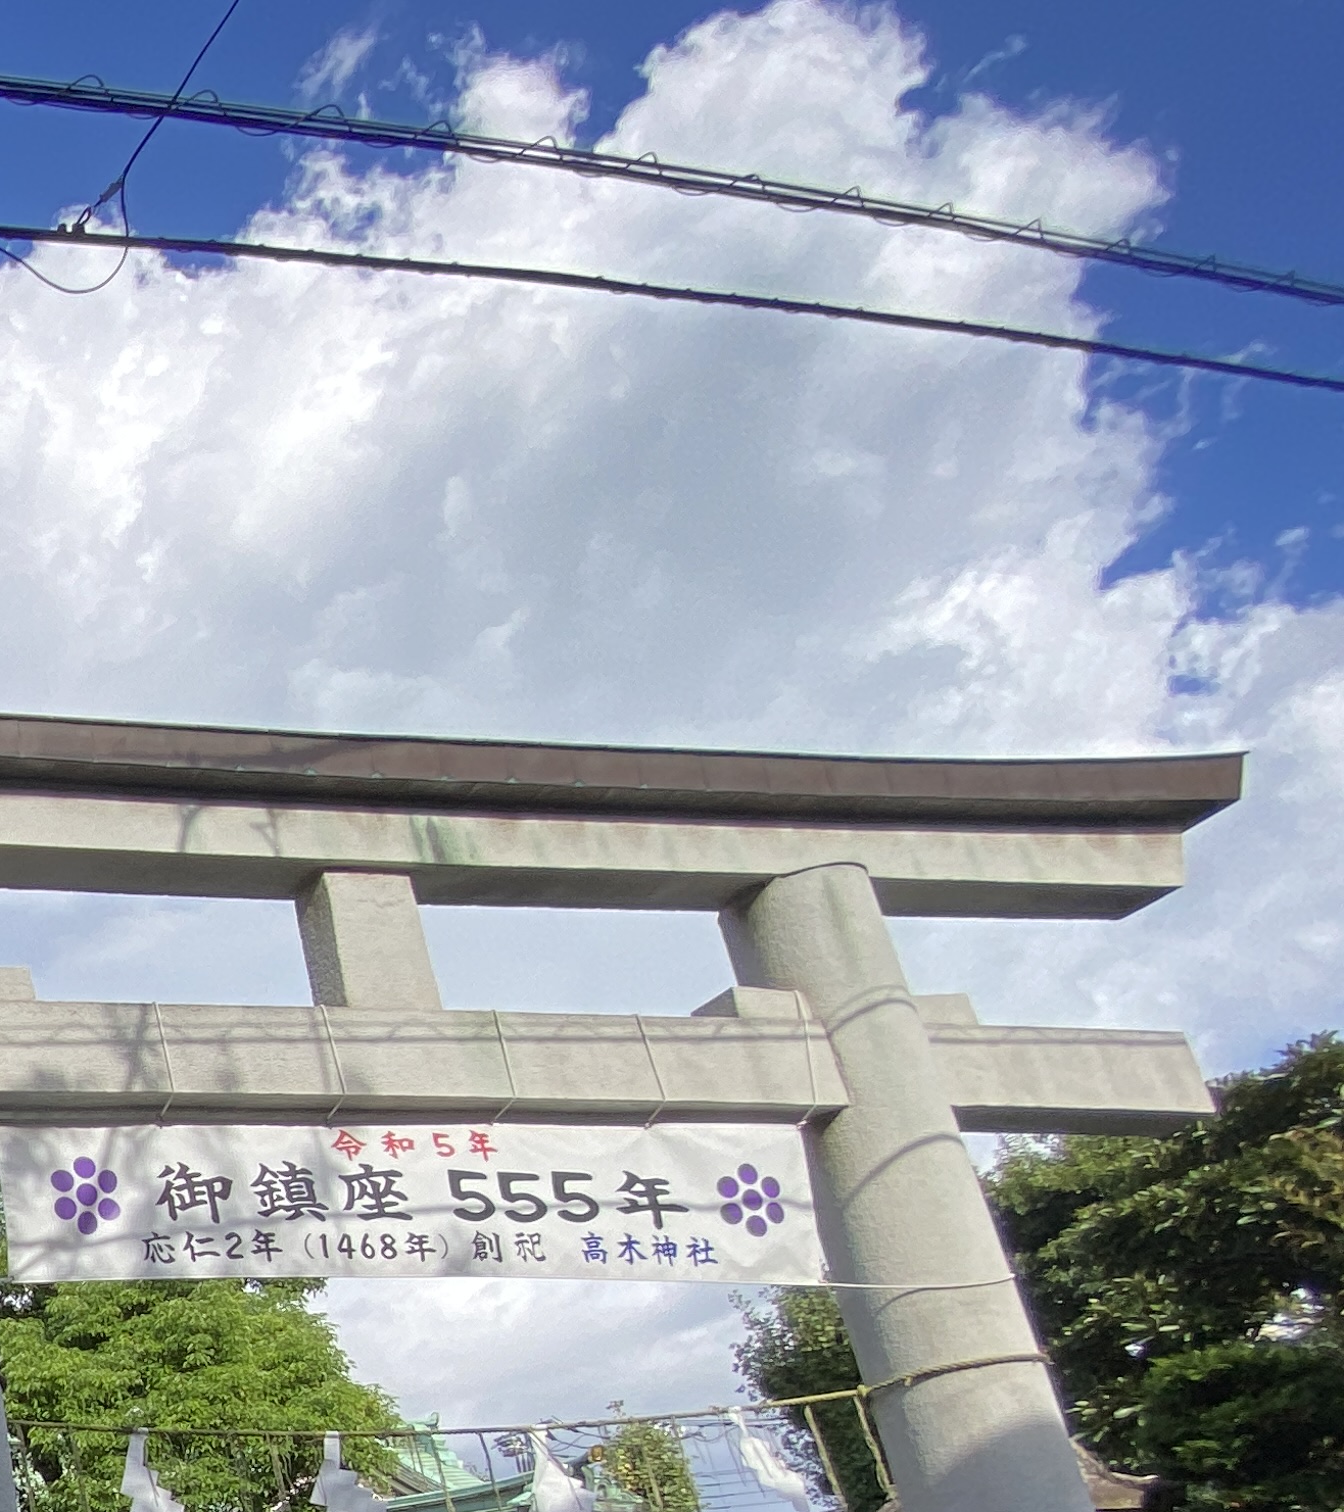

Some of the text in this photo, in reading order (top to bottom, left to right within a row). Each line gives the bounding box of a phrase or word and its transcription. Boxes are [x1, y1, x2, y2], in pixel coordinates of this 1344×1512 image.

[330, 1129, 499, 1162] 令和5年
[155, 1160, 690, 1230] 御鎮座 555年
[580, 1230, 719, 1267] 高木神社
